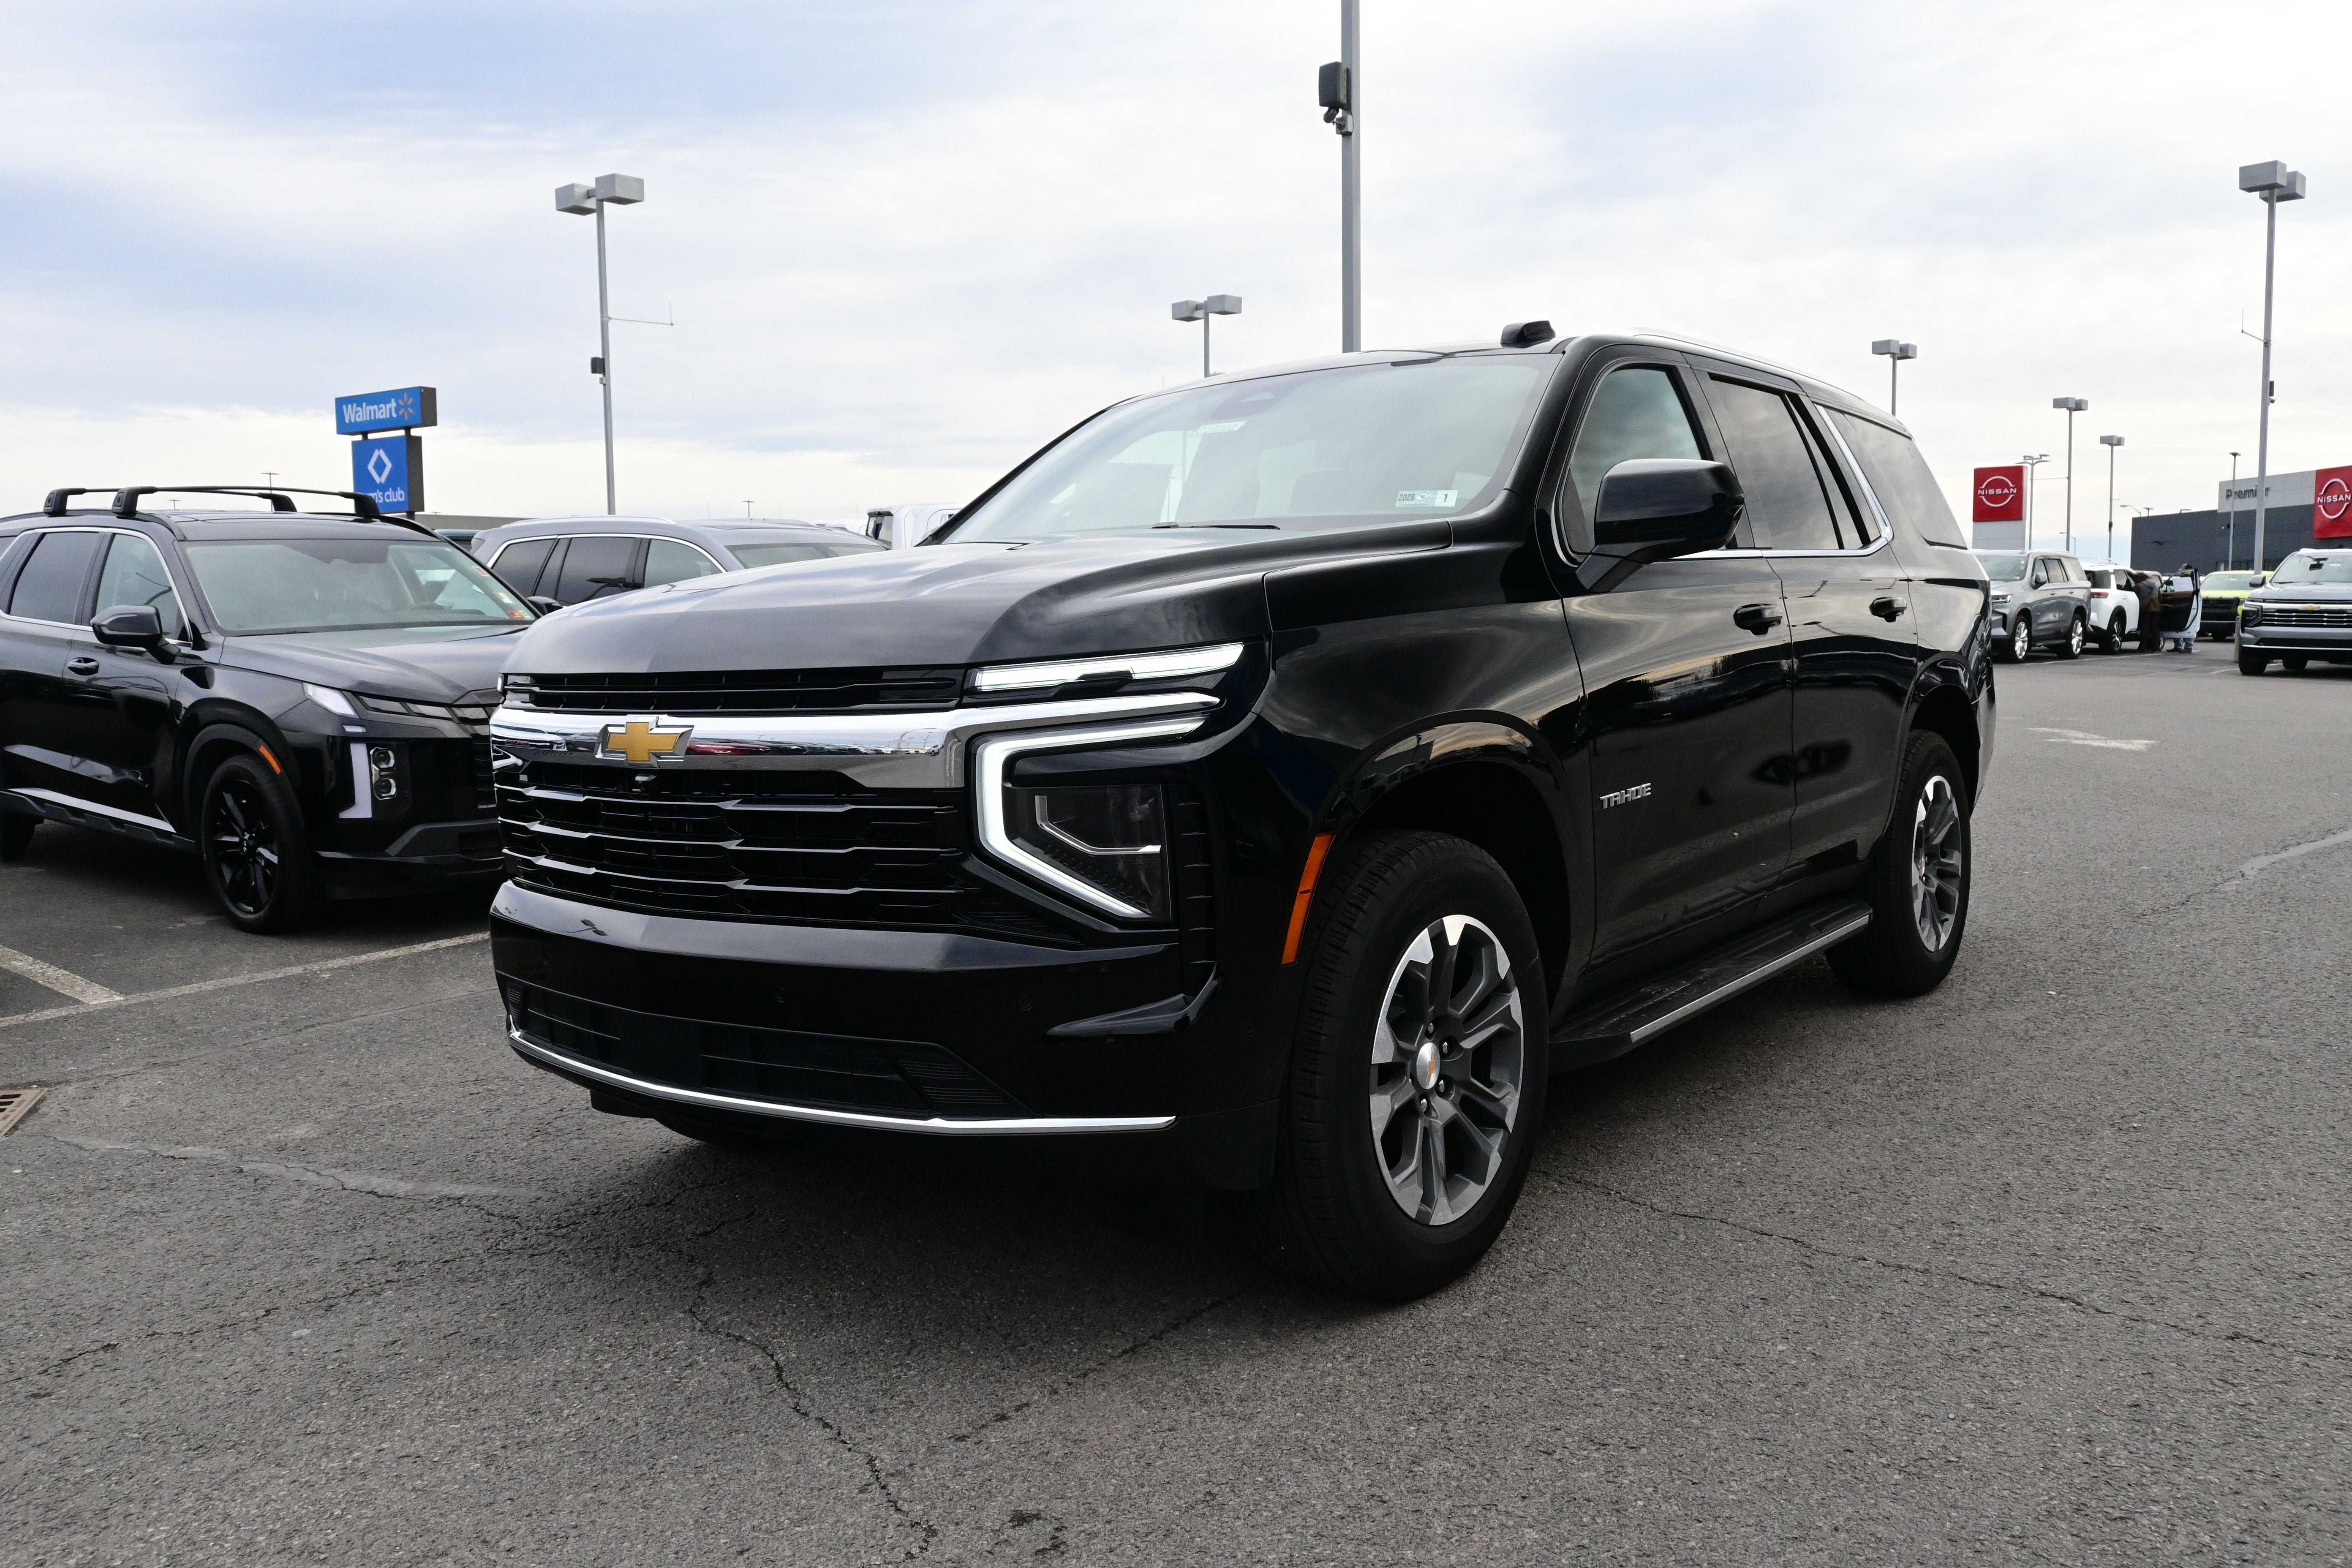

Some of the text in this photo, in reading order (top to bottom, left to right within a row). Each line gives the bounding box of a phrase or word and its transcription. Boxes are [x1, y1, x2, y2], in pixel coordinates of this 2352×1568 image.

[343, 398, 397, 423] Walmart
[384, 487, 405, 502] club
[1398, 493, 1448, 502] 2028 1
[1978, 487, 2017, 495] NISSAN
[2226, 485, 2271, 501] Premir
[2317, 493, 2351, 504] NISSAN
[1599, 782, 1652, 809] TAHOE
